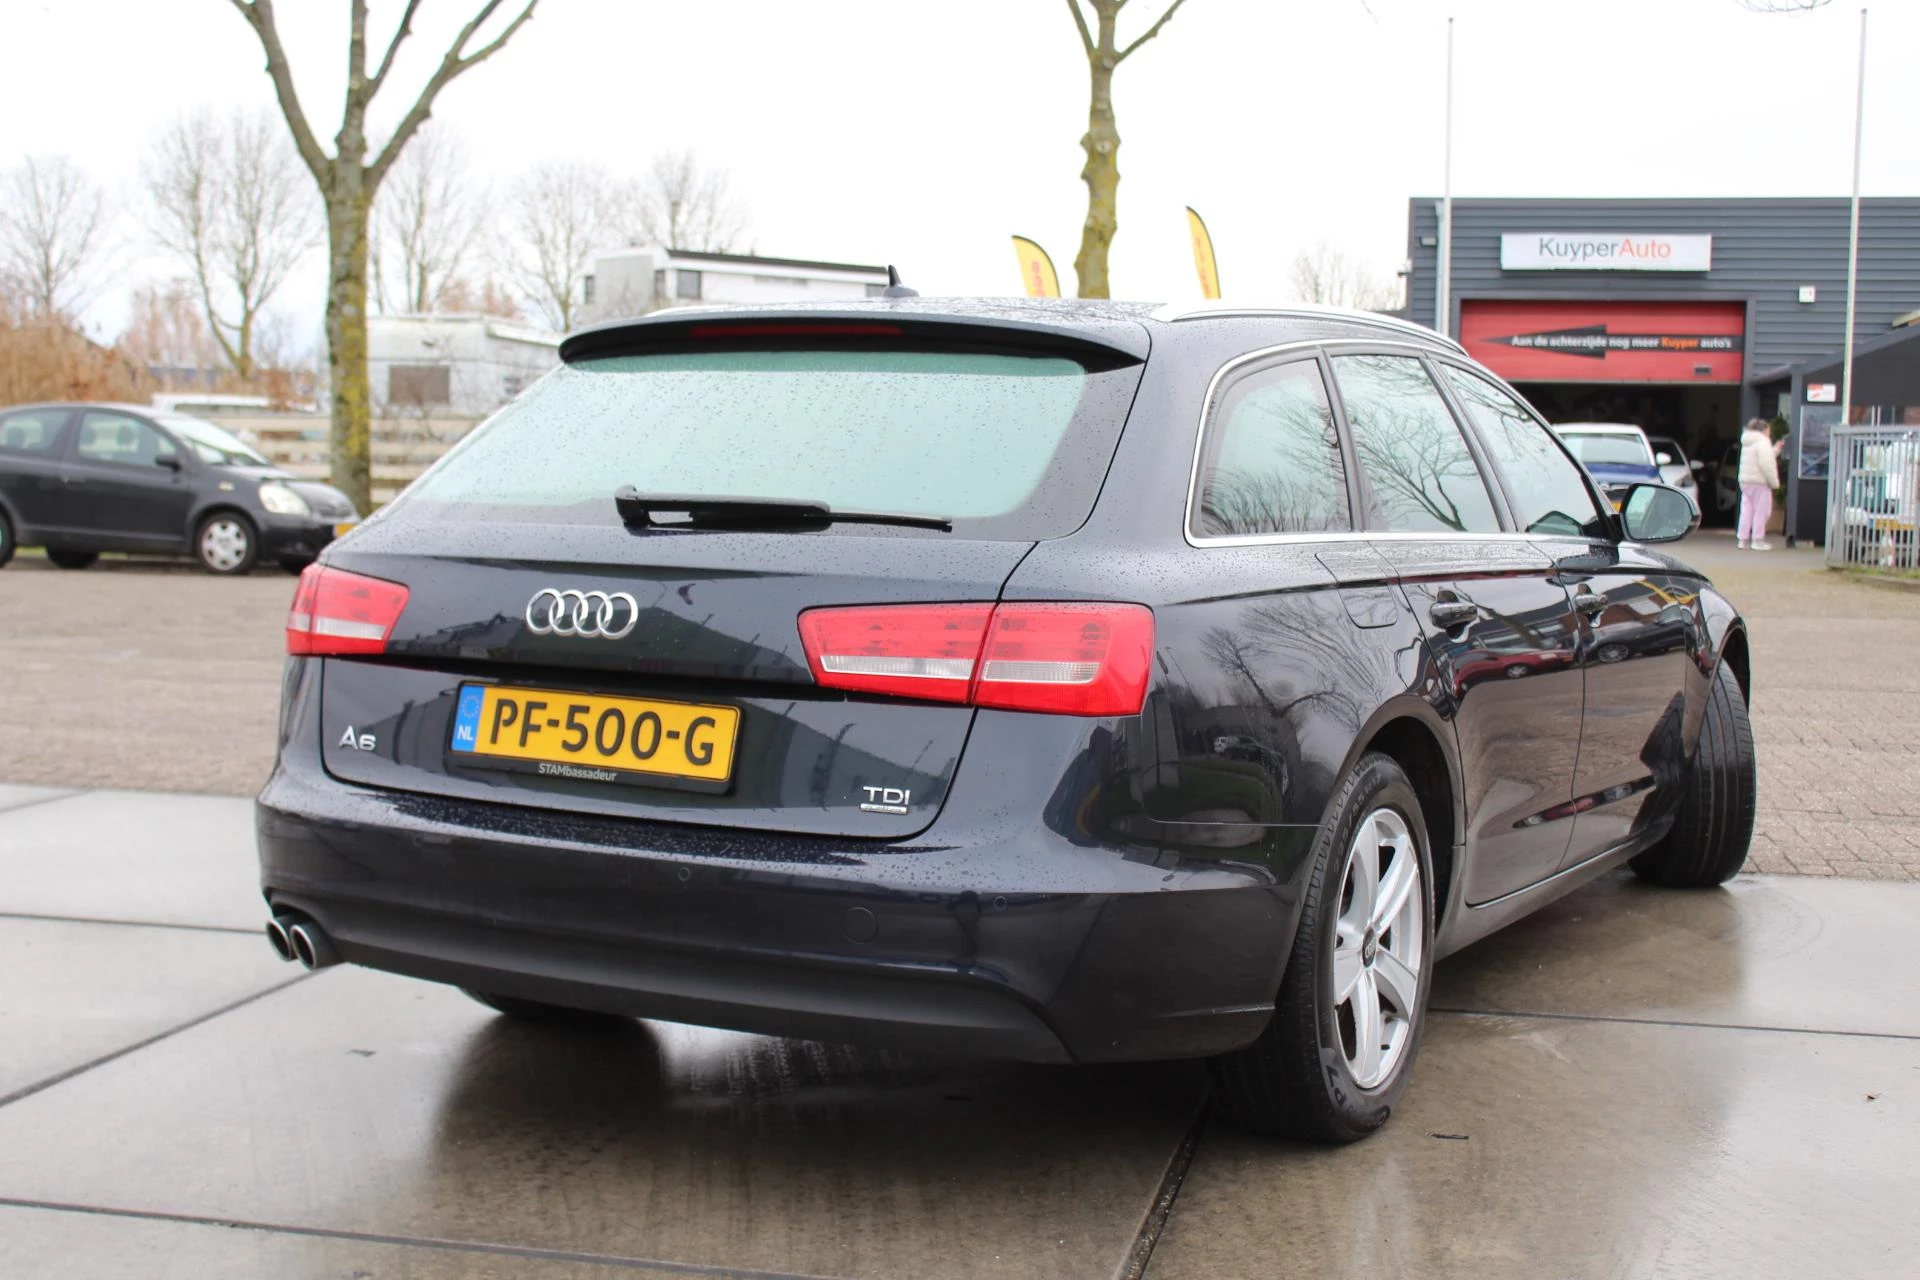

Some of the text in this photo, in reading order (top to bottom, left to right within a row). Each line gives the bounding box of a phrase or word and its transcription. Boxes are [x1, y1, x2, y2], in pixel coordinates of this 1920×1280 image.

[1539, 237, 1671, 261] KuyperAuto
[1511, 334, 1732, 350] Aan de achterzijde nog meer Kuyper auto's
[339, 725, 376, 751] A6
[457, 726, 474, 741] NL
[490, 698, 716, 766] PF-500-G
[538, 762, 618, 782] STAMbassadeur
[863, 786, 911, 805] TDI
